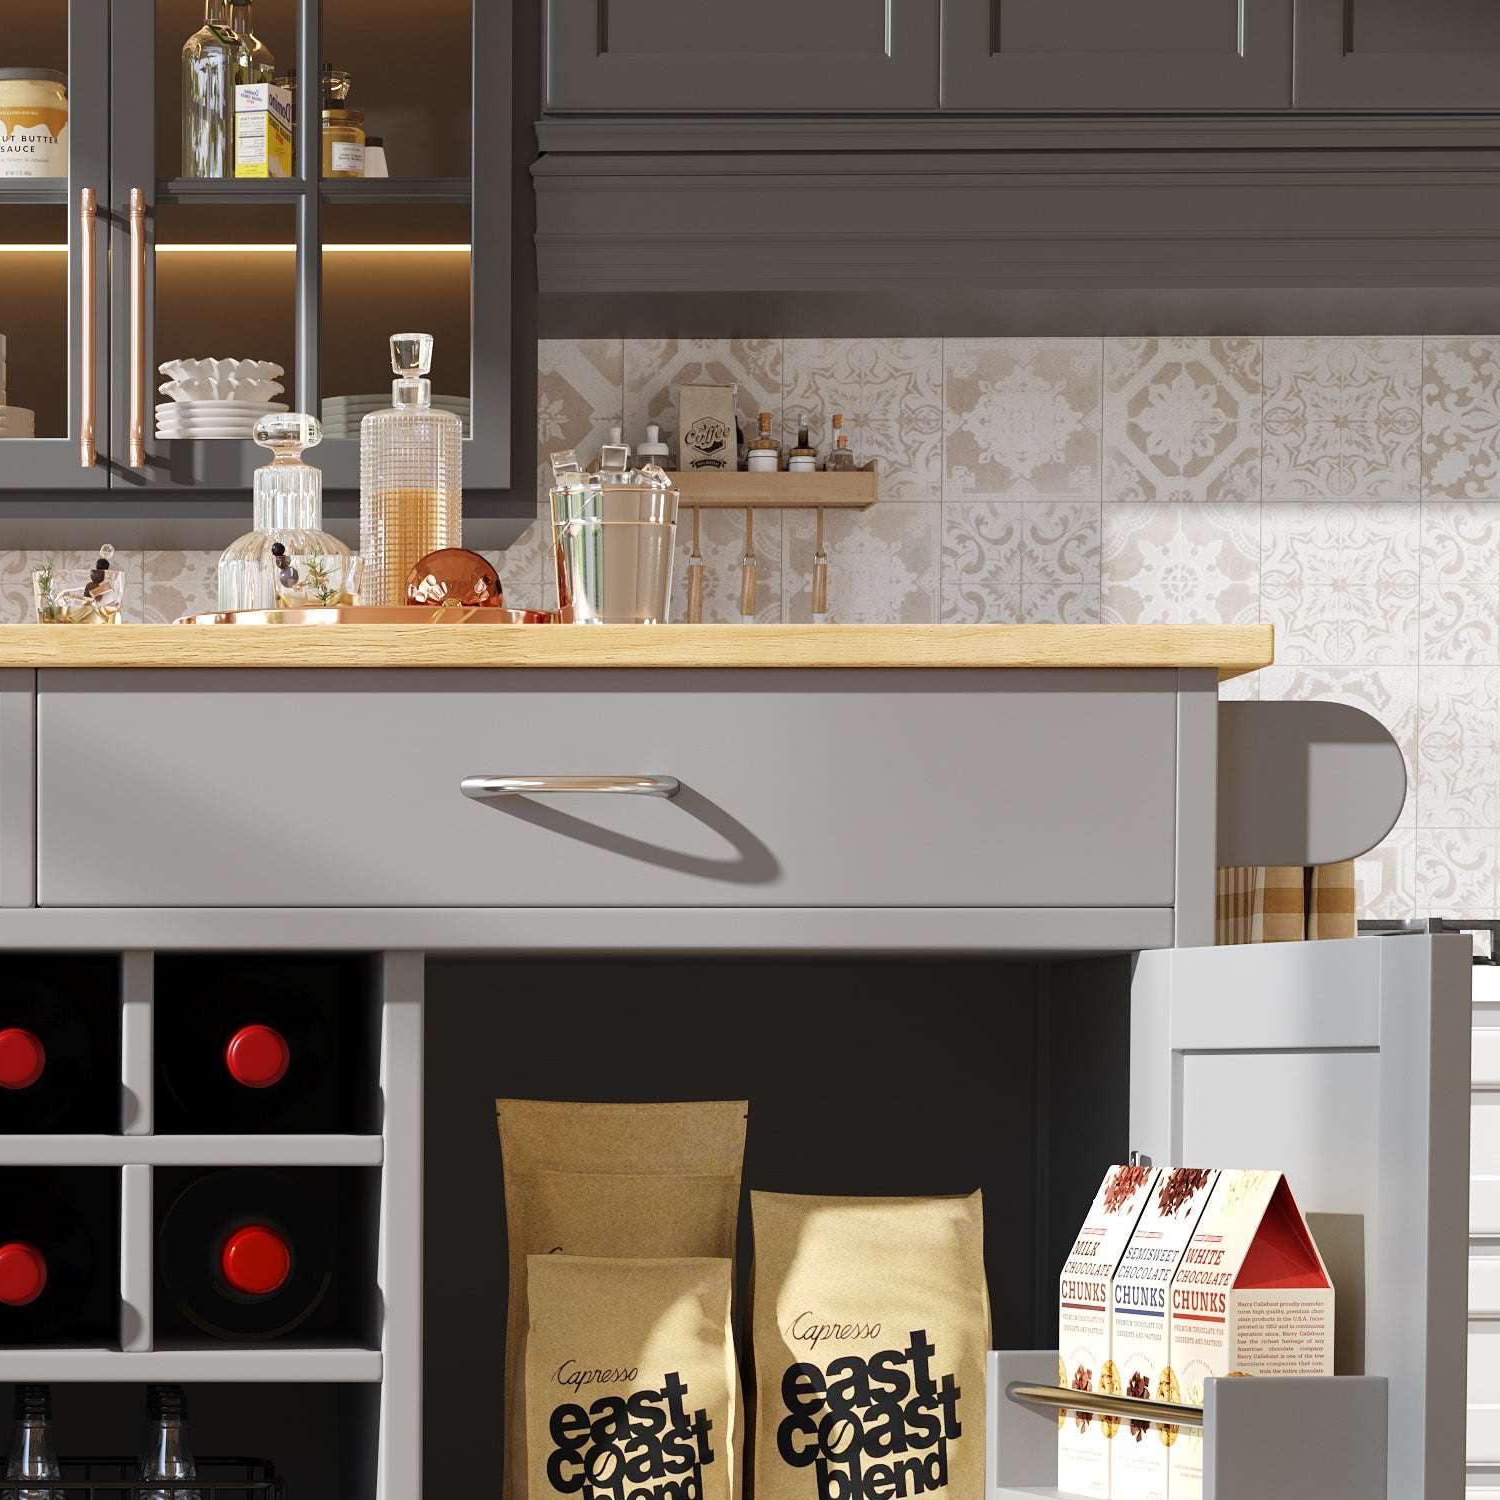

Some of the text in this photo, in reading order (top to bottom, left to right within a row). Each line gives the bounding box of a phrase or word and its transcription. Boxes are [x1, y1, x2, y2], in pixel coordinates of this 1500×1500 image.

[21, 135, 59, 144] BUTTER
[685, 425, 730, 445] Coffee
[1073, 1241, 1100, 1256] MILK
[1126, 1247, 1180, 1262] SEMISWEET
[1185, 1248, 1225, 1265] WHITE
[1064, 1262, 1112, 1277] CHOCOLATE
[1118, 1265, 1171, 1281] CHOCOLATE
[1176, 1270, 1232, 1286] CHOCOLATE
[1061, 1280, 1106, 1302] CHUNKS
[1115, 1285, 1165, 1308] CHUNKS
[1173, 1289, 1226, 1313] CHUNKS
[785, 1310, 882, 1350] Capresso
[551, 1358, 639, 1393] Capresso
[780, 1330, 938, 1418] east
[549, 1372, 688, 1450] east
[776, 1373, 961, 1469] coast
[546, 1409, 715, 1494] coast
